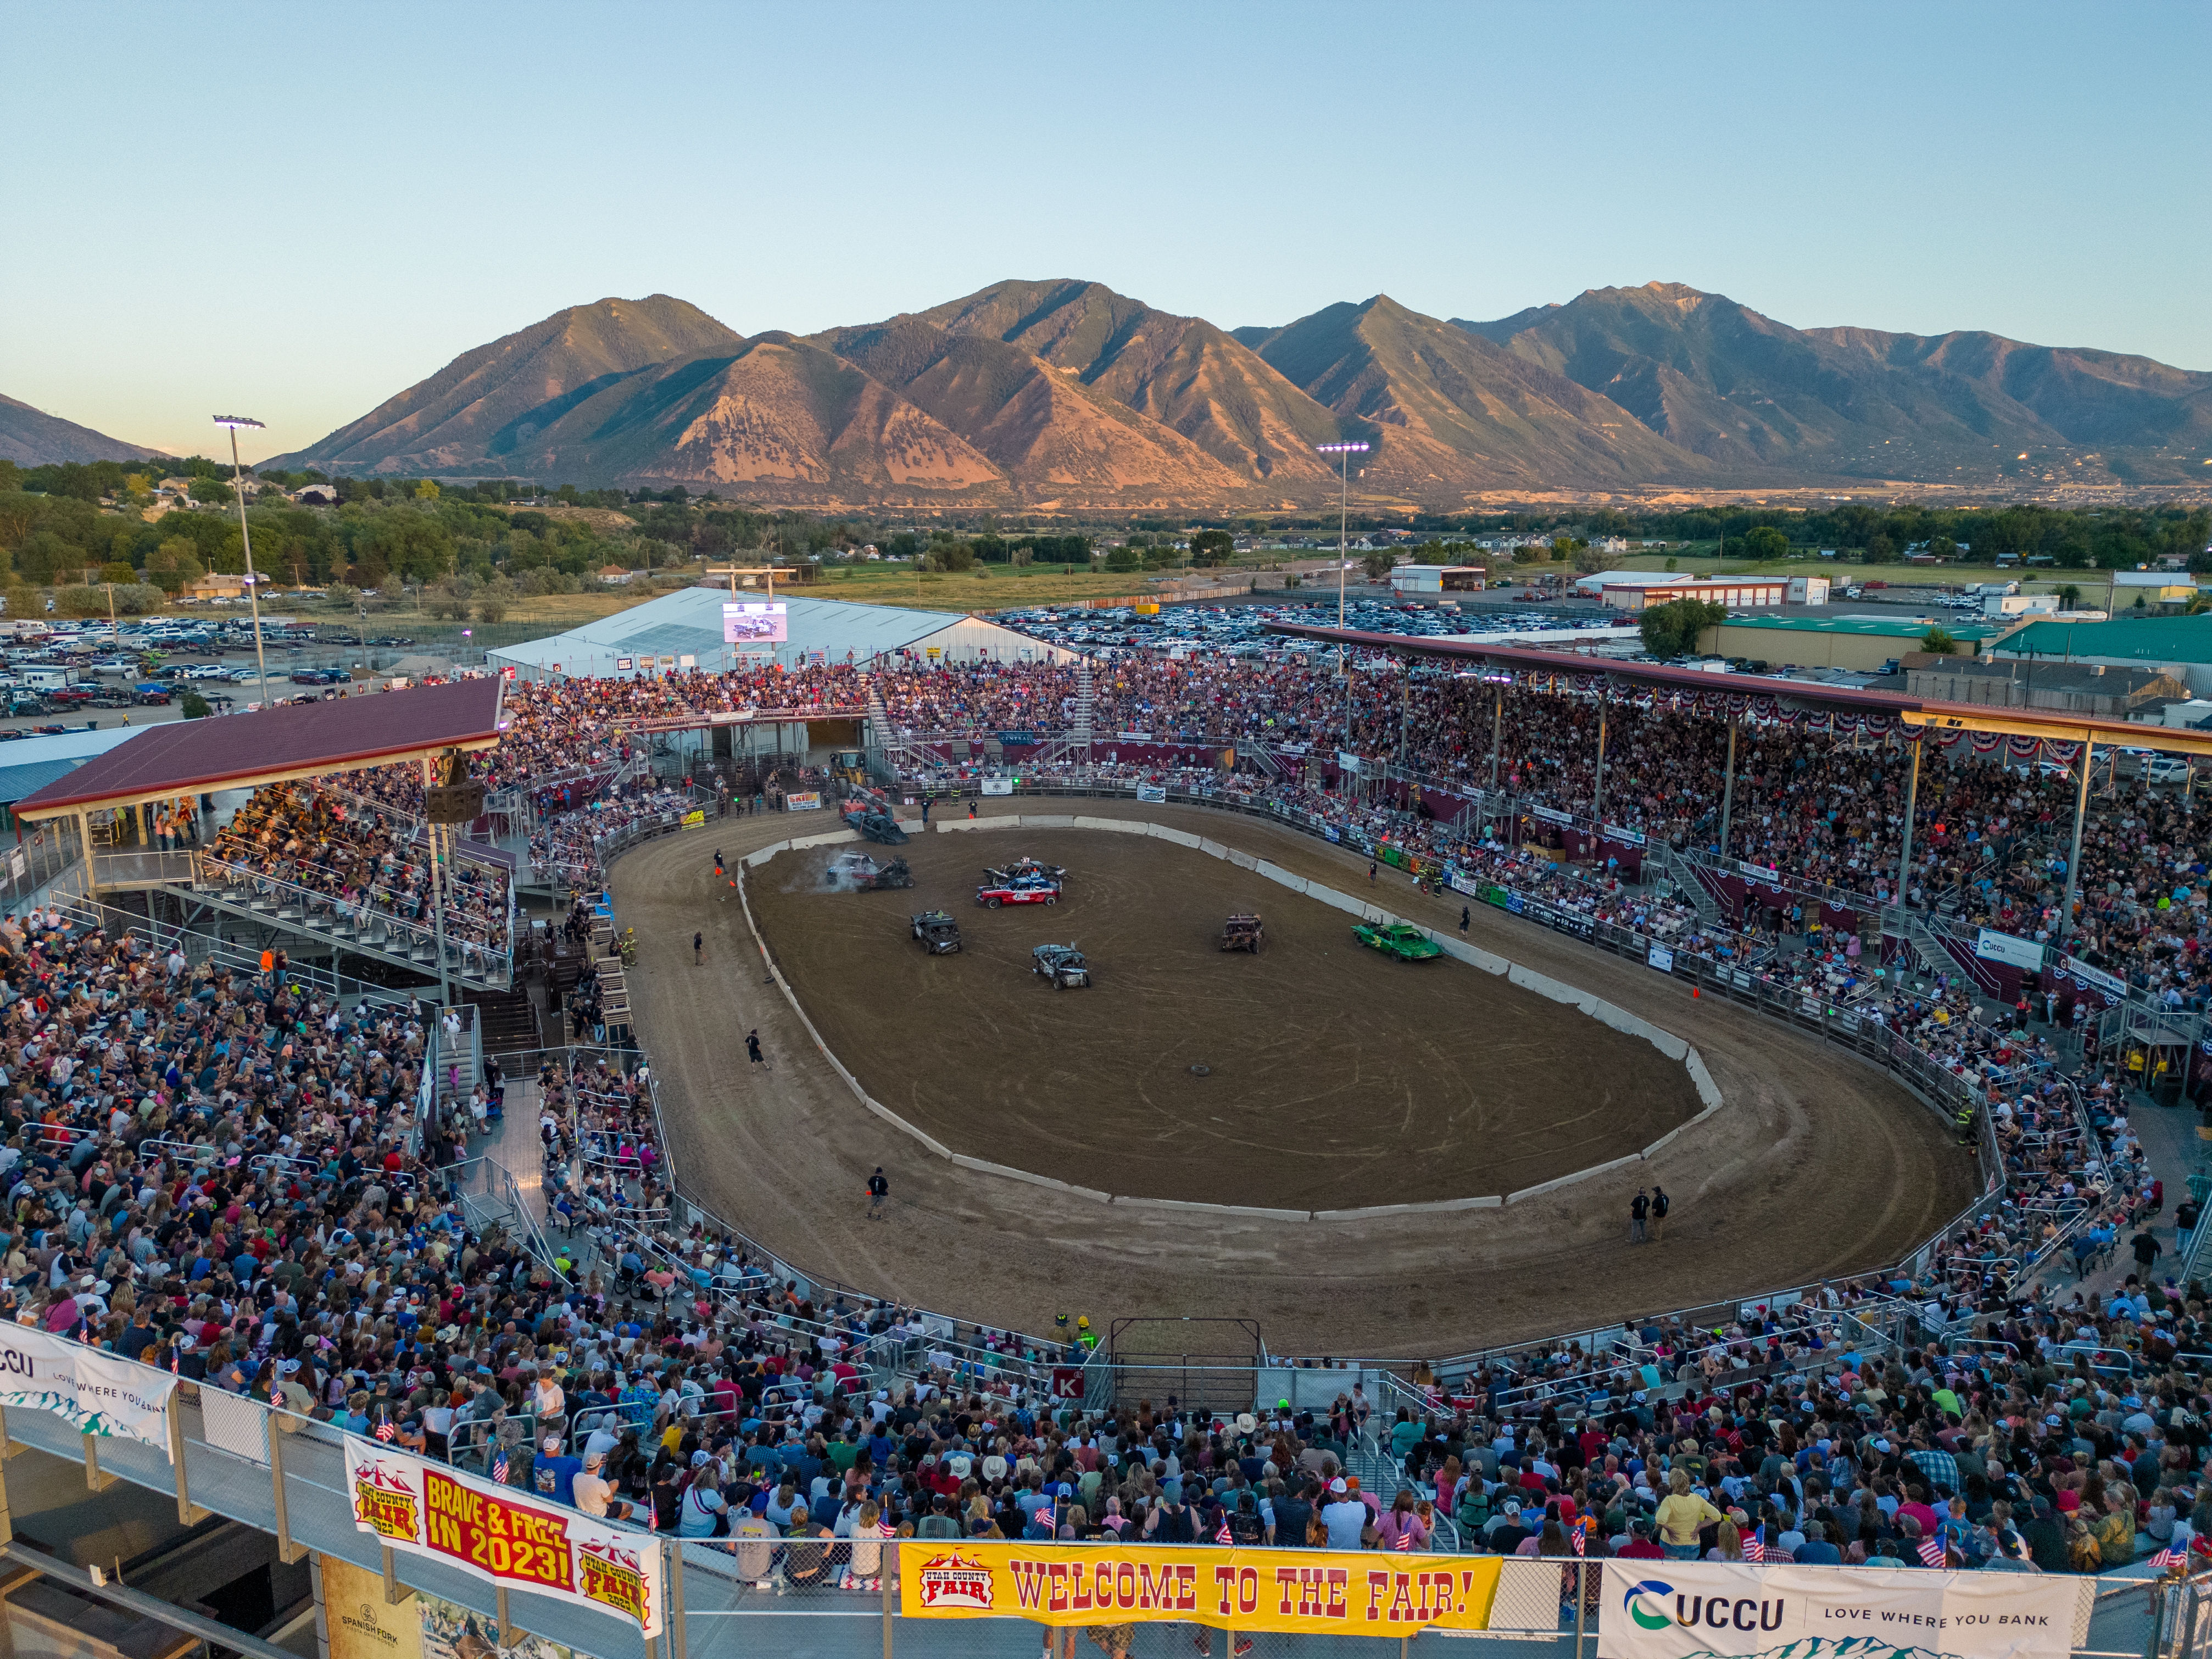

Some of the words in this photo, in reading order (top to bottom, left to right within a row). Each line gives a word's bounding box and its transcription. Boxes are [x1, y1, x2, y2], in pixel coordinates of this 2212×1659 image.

[1989, 944, 2005, 953] UCCU
[2060, 959, 2066, 968] G
[2072, 961, 2088, 974] WRECKING
[2094, 972, 2108, 983] SPONSOR
[2112, 980, 2125, 990] Jones
[928, 1317, 946, 1327] CIRCLE
[53, 1372, 75, 1387] LOVE
[76, 1382, 118, 1398] WHERE
[122, 1391, 141, 1406] YOU
[141, 1401, 167, 1413] BANK
[1060, 1378, 1076, 1396] K
[376, 1489, 411, 1509] COUNTY
[427, 1476, 483, 1524] BRAVE
[487, 1502, 505, 1536] &
[510, 1508, 569, 1550] FREE
[429, 1510, 462, 1553] IN
[470, 1529, 570, 1586] 2023!
[584, 1554, 607, 1574] UTAH
[926, 1571, 951, 1580] UTAH
[952, 1572, 987, 1581] COUNTY
[586, 1569, 641, 1608] FAIR
[927, 1580, 988, 1604] FAIR
[1010, 1560, 1196, 1611] WELCOME
[1215, 1566, 1258, 1616] TO
[1277, 1567, 1347, 1618] THE
[1366, 1570, 1474, 1622] FAIR!
[608, 1593, 631, 1609] 2023
[1676, 1594, 1784, 1632] UCCU
[1825, 1607, 1871, 1620] LOVE
[1881, 1612, 1947, 1629] WHERE
[1955, 1614, 1990, 1627] YOU
[1999, 1615, 2049, 1627] BANK
[342, 1616, 376, 1634] SPANISH
[377, 1627, 398, 1645] FORK
[347, 1625, 363, 1634] FIESTA
[364, 1631, 376, 1640] DAYS
[377, 1636, 395, 1648] RODEO
